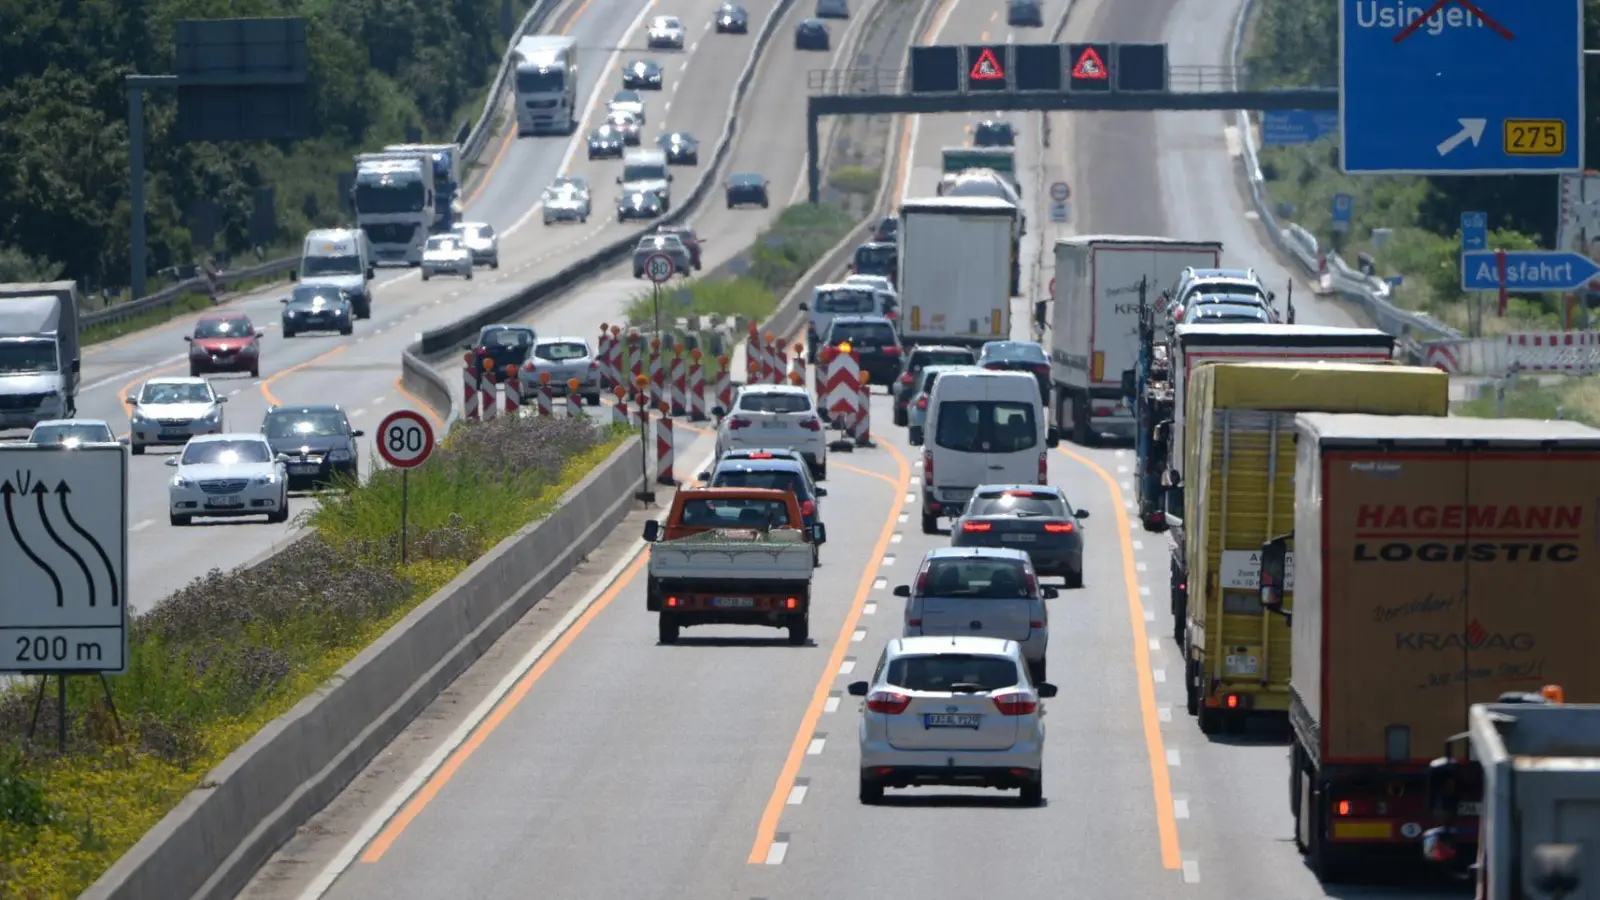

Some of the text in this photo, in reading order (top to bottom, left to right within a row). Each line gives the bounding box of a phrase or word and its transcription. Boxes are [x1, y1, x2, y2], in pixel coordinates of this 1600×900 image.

[1356, 1, 1484, 35] Usingen
[1512, 127, 1557, 148] 275
[390, 426, 421, 452] 80
[1355, 504, 1583, 530] HAGEMANN
[1353, 543, 1580, 563] LOGISTIC
[16, 636, 102, 661] 200 m
[1395, 632, 1537, 651] KRAVAG
